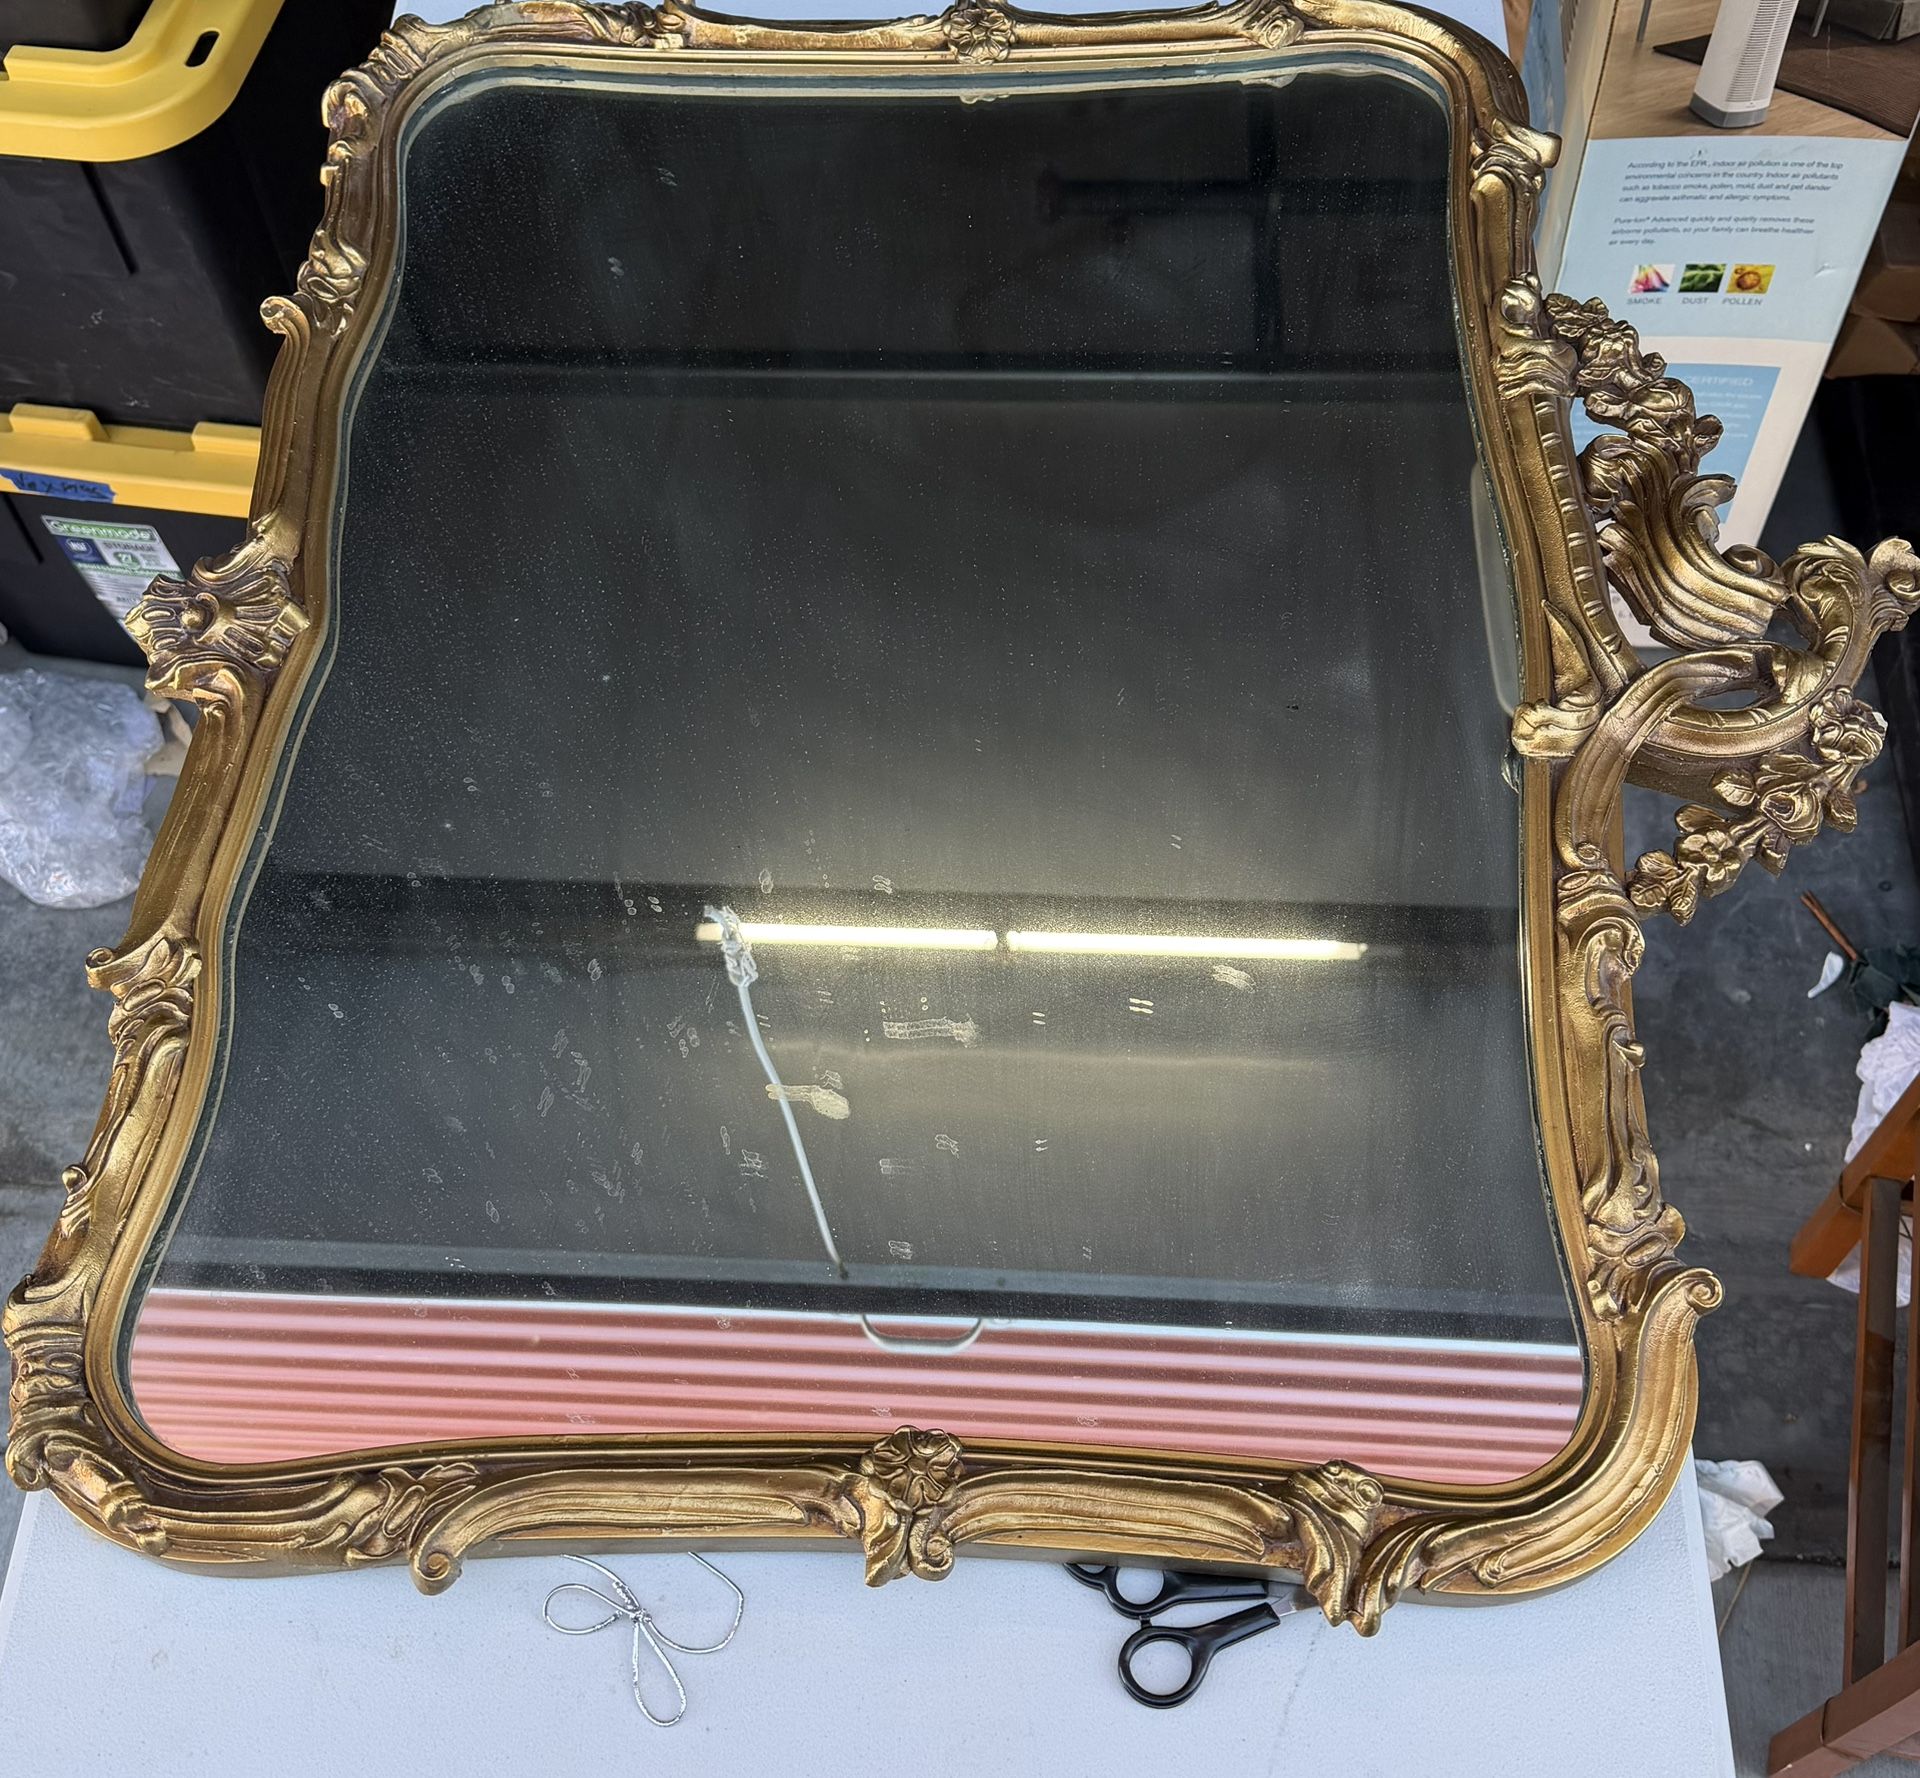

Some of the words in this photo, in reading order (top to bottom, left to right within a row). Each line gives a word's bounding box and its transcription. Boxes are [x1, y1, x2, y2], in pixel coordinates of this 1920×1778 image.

[1748, 160, 1781, 168] pollution
[1831, 161, 1843, 169] top
[1802, 172, 1839, 180] pollutants
[1757, 182, 1775, 190] dust
[1692, 227, 1711, 235] your
[1626, 297, 1663, 305] SMOKE
[1681, 297, 1710, 305] DUST
[1721, 297, 1763, 306] POLLEN
